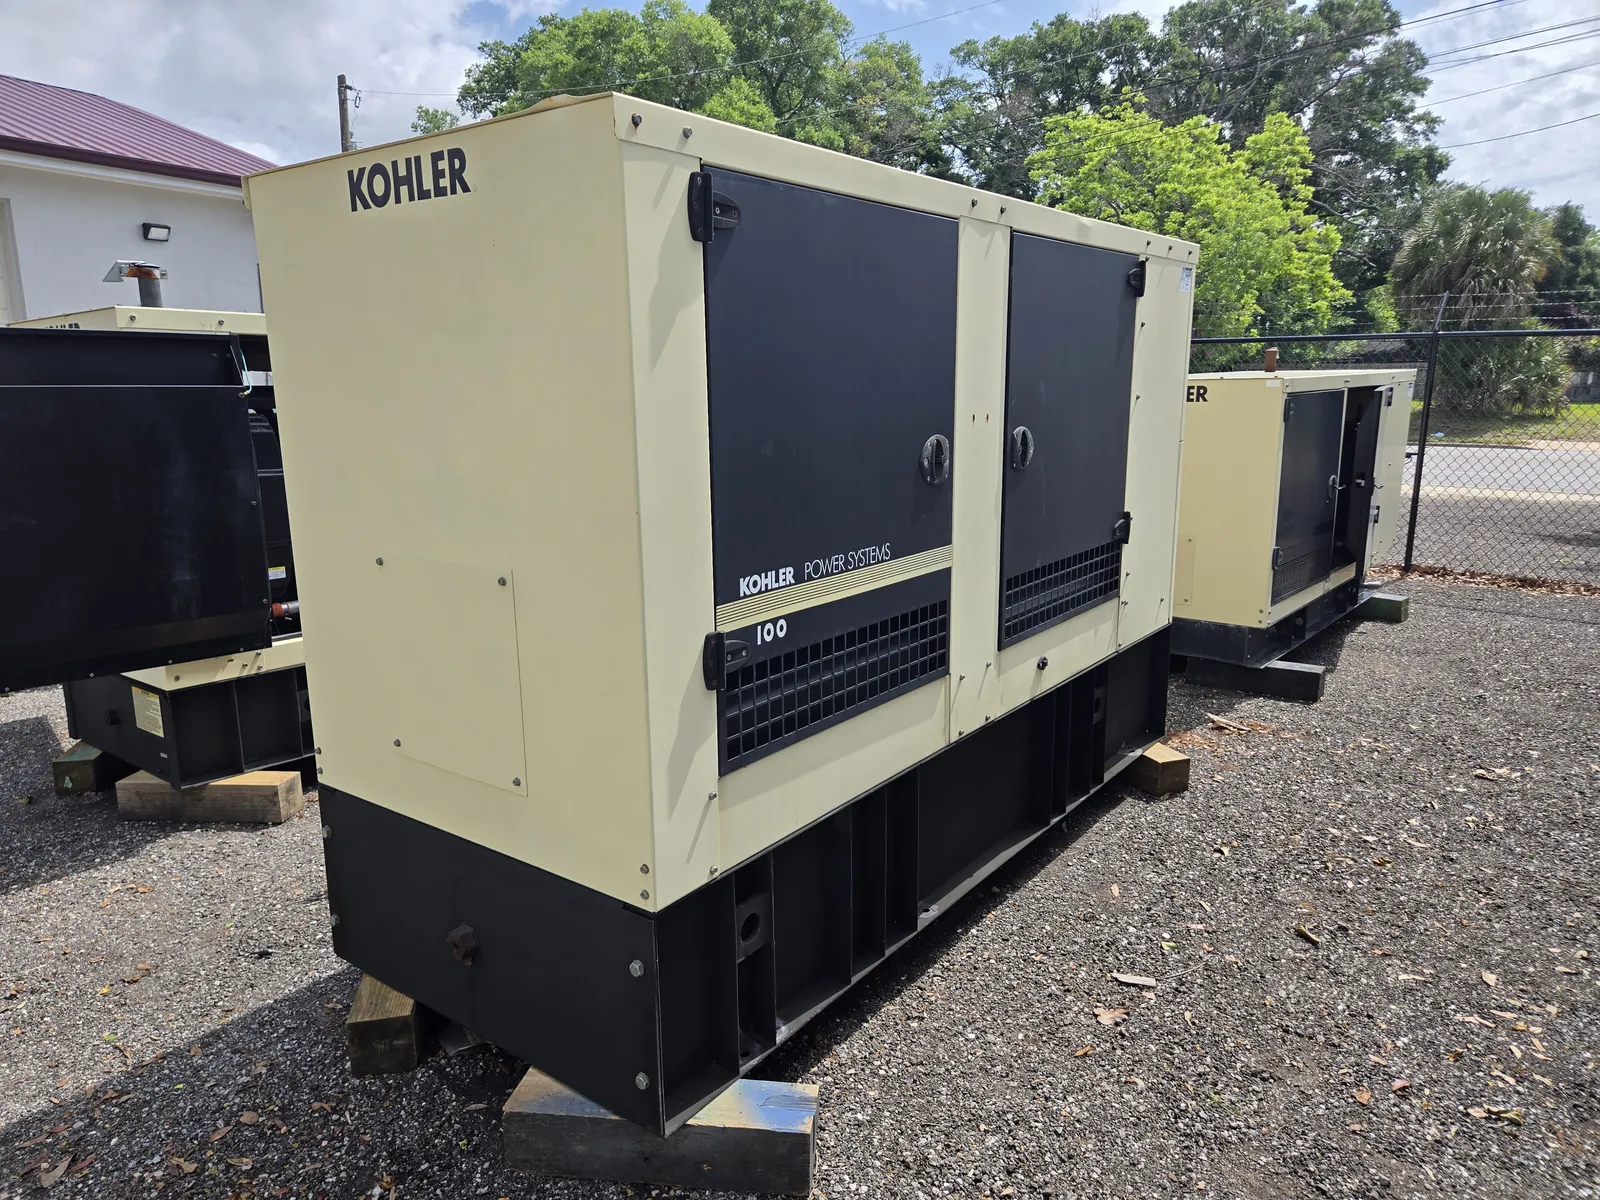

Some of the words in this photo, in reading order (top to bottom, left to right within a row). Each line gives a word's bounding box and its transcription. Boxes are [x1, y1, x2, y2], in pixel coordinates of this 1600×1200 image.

[347, 147, 471, 212] KOHLER
[739, 566, 795, 597] KOHLER
[804, 554, 846, 580] POWER
[847, 542, 891, 570] SYSTEMS
[757, 618, 787, 645] 100
